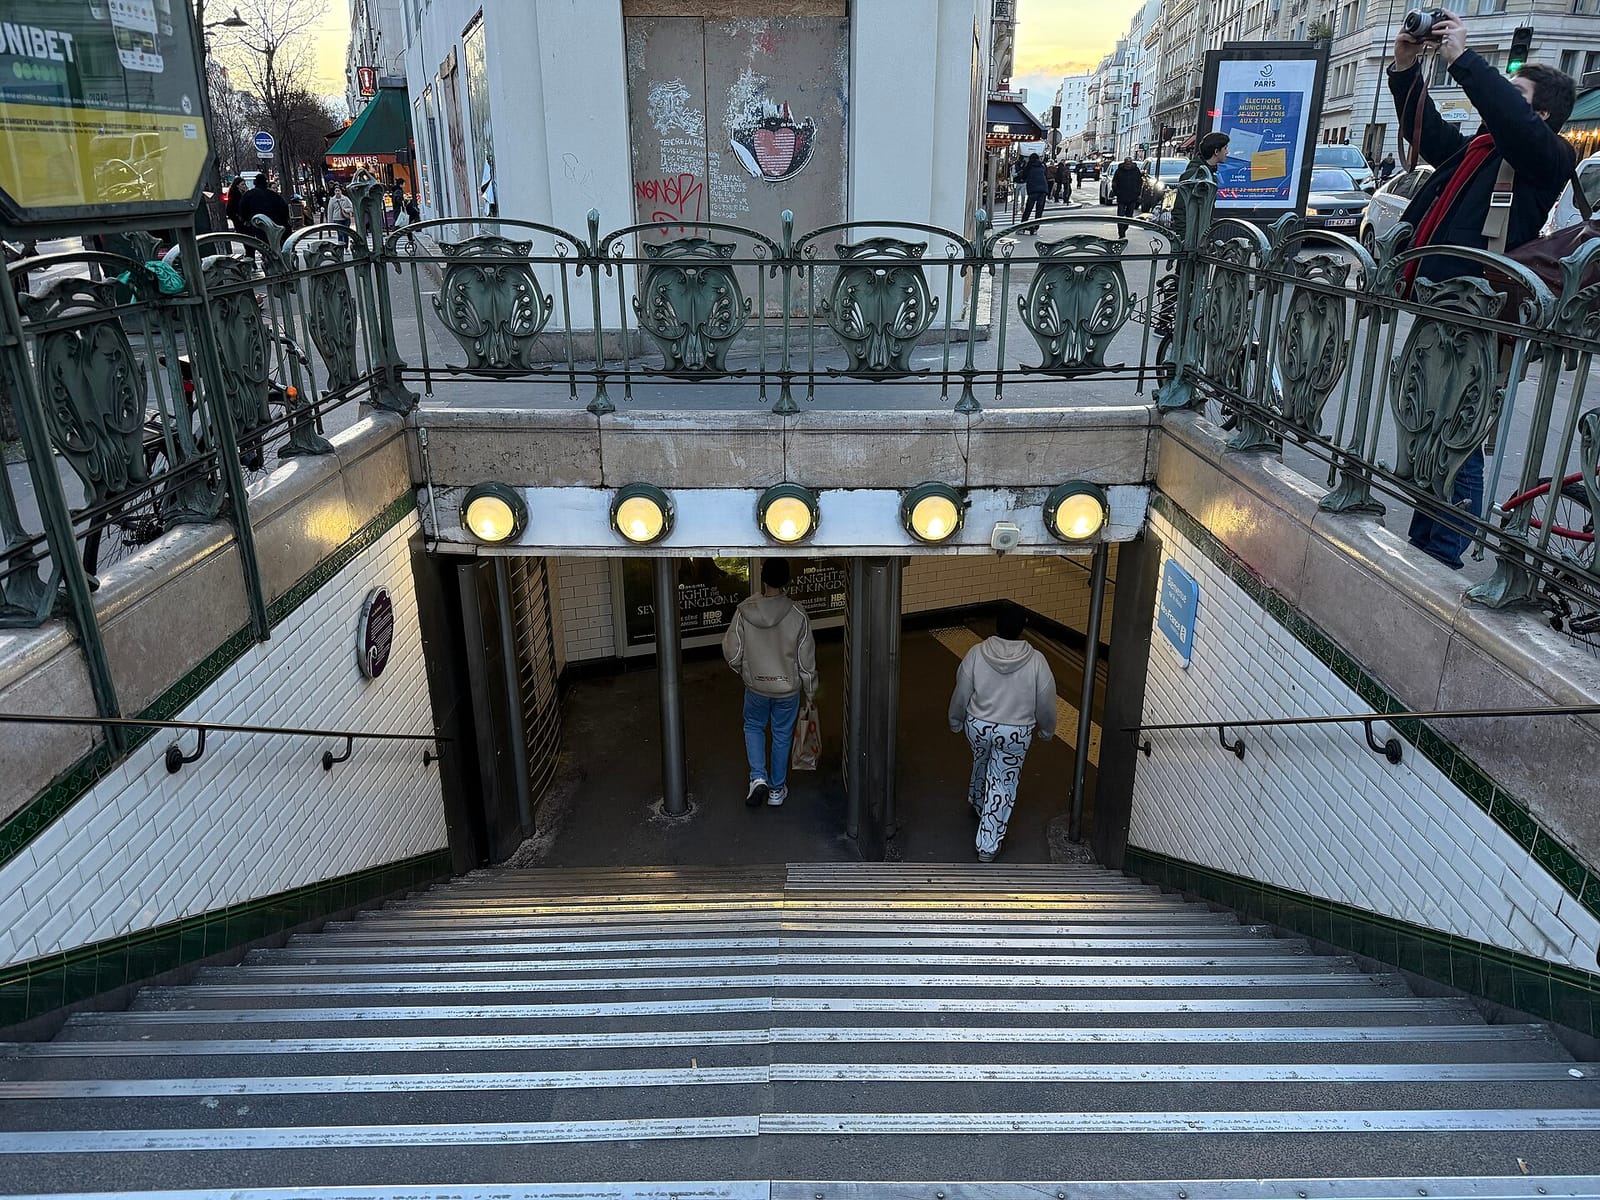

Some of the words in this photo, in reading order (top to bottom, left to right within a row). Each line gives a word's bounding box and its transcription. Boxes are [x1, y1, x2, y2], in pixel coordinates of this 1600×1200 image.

[1254, 80, 1276, 88] PARIS
[333, 156, 378, 164] PRIMEURS
[797, 571, 838, 585] KNIGHT
[782, 585, 804, 595] VEN
[806, 579, 846, 593] KINGD
[678, 587, 710, 601] IGHT
[637, 604, 655, 616] SEV
[703, 610, 723, 620] HBO
[703, 618, 723, 626] max
